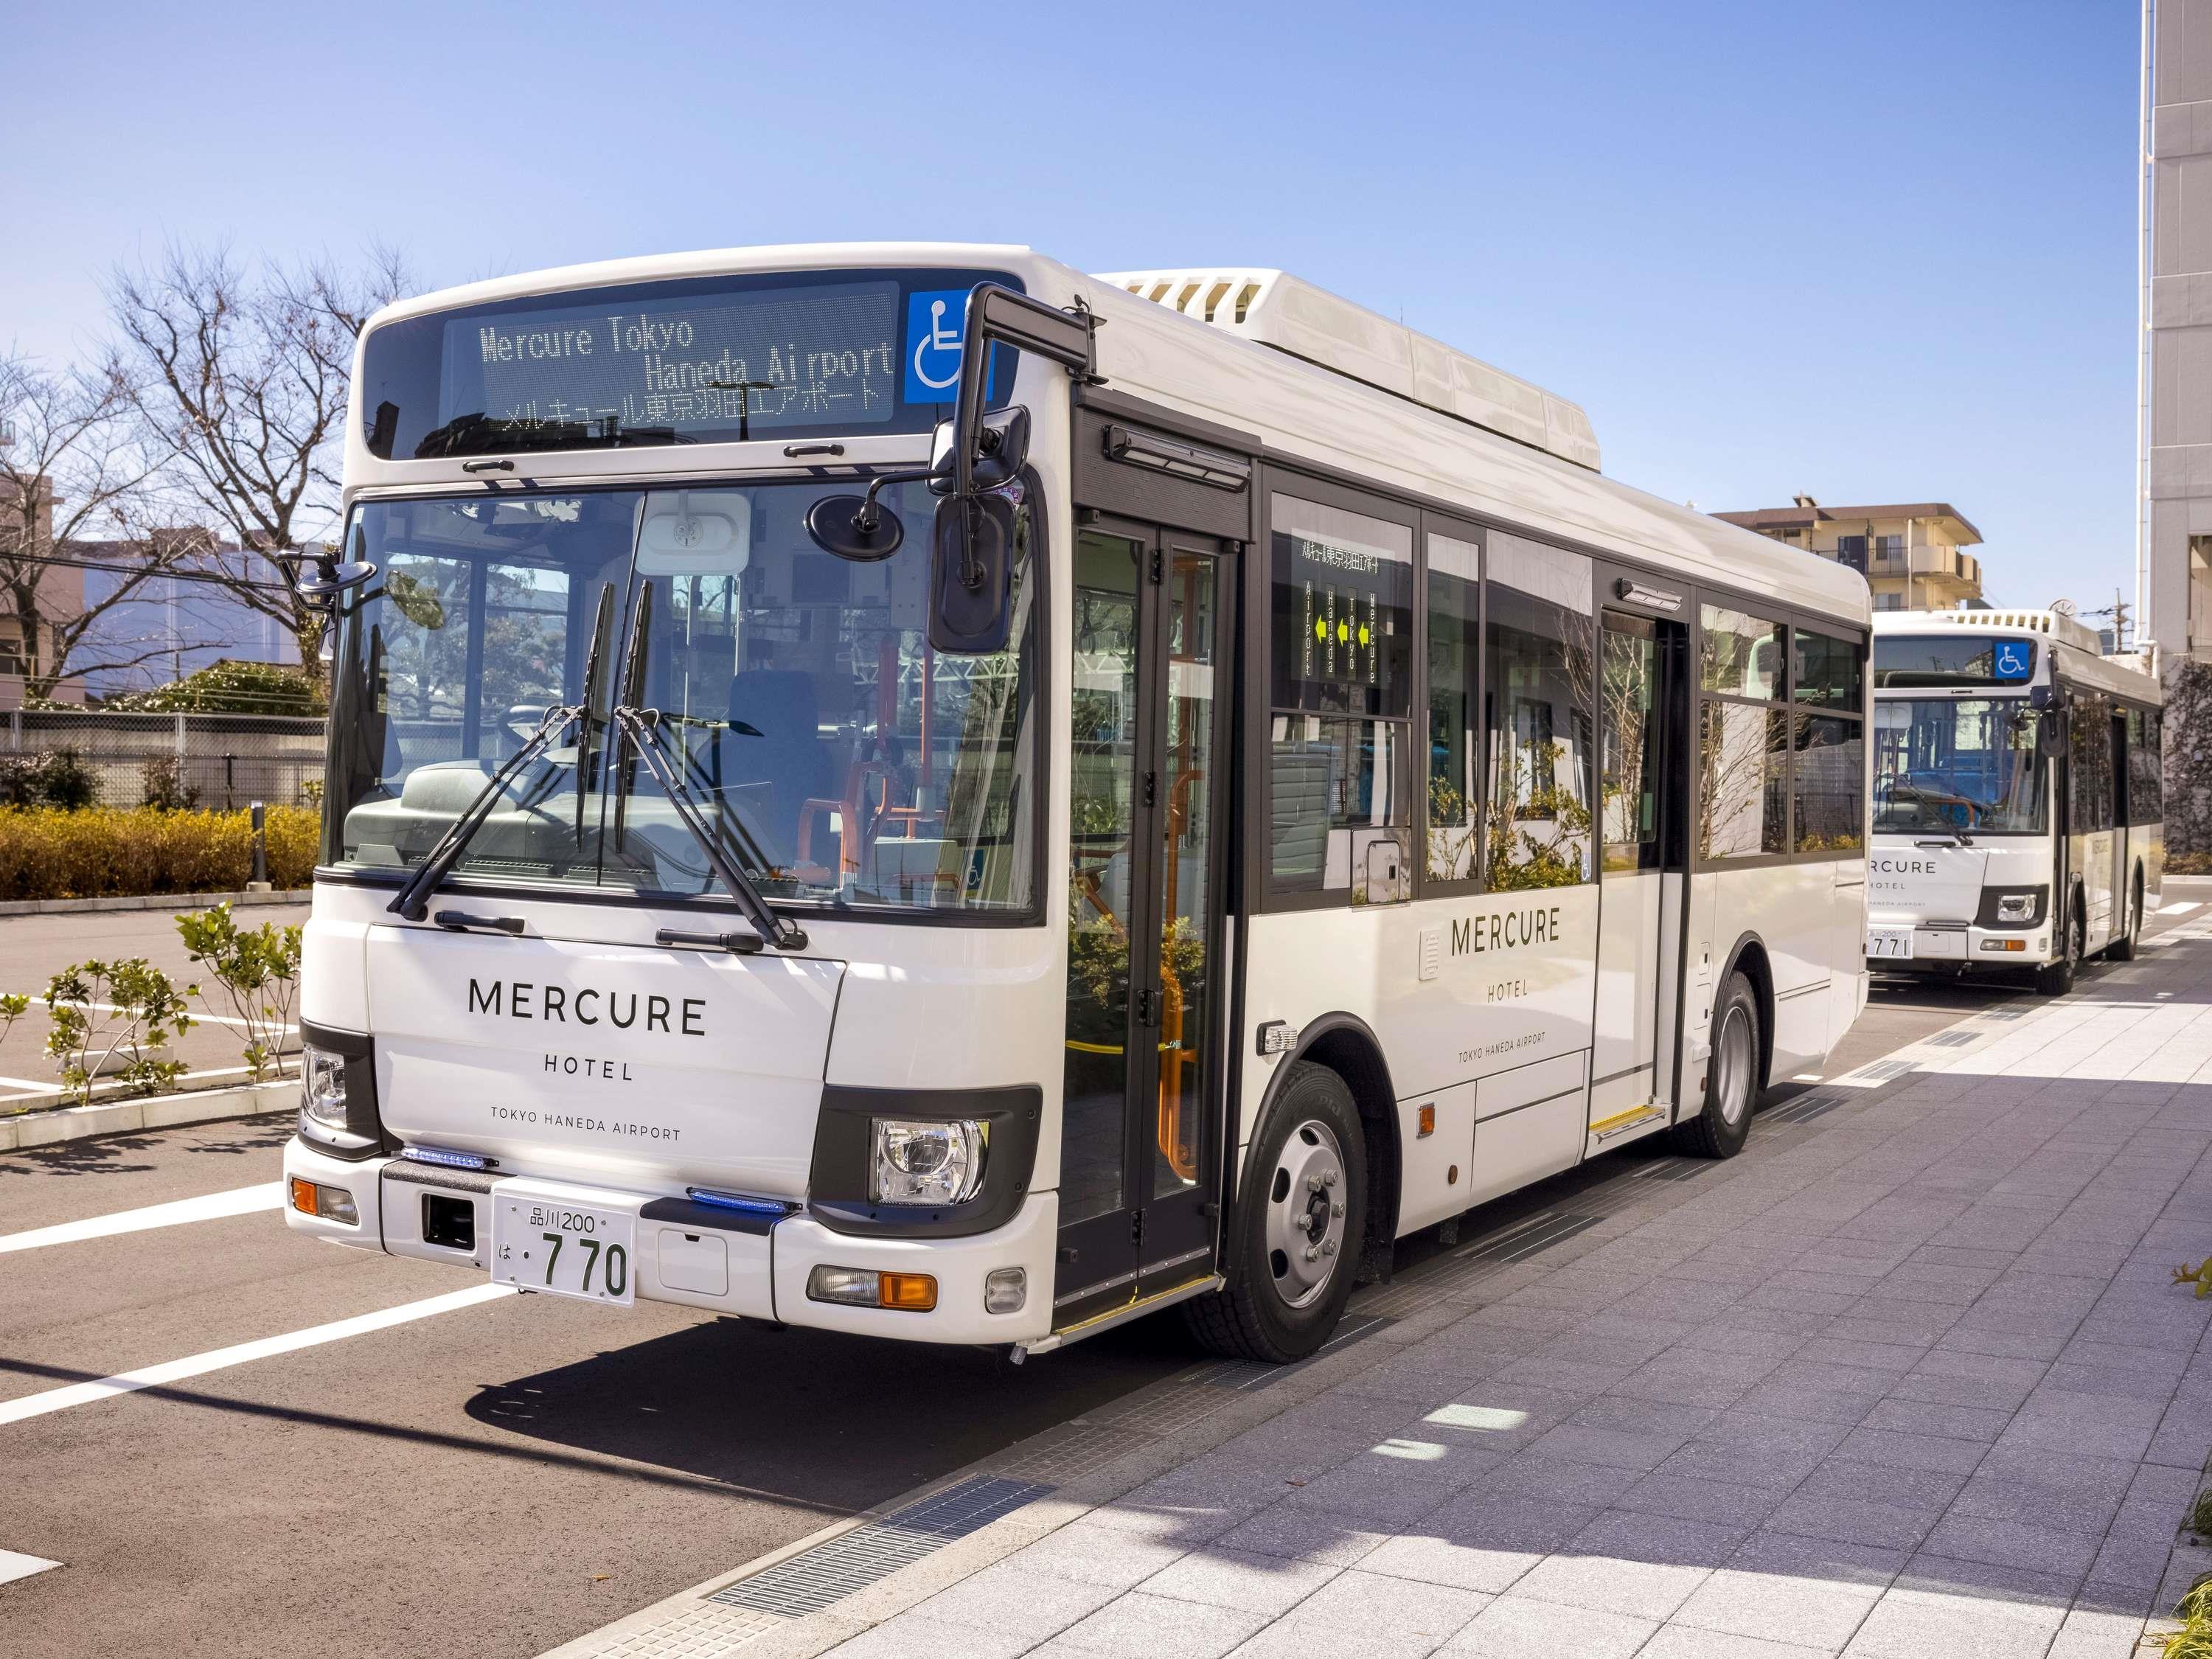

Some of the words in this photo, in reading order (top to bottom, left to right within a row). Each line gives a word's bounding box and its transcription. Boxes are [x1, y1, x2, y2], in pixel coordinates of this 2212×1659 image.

[480, 327, 593, 362] Mercure
[607, 314, 693, 352] Tokyo
[644, 348, 748, 390] Haneda
[767, 341, 894, 382] Airport
[1451, 907, 1560, 956] MERCURE
[468, 978, 706, 1037] MERCURE
[1487, 979, 1528, 1004] HOTEL
[1458, 1047, 1483, 1063] TOKYO
[1485, 1039, 1514, 1057] HANEDA
[1516, 1032, 1545, 1049] AIRPORT
[544, 1054, 633, 1081] HOTEL
[490, 1106, 538, 1123] TOKYO
[544, 1113, 605, 1133] HANEDA
[612, 1122, 681, 1141] AIRPORT
[498, 1243, 511, 1259] は
